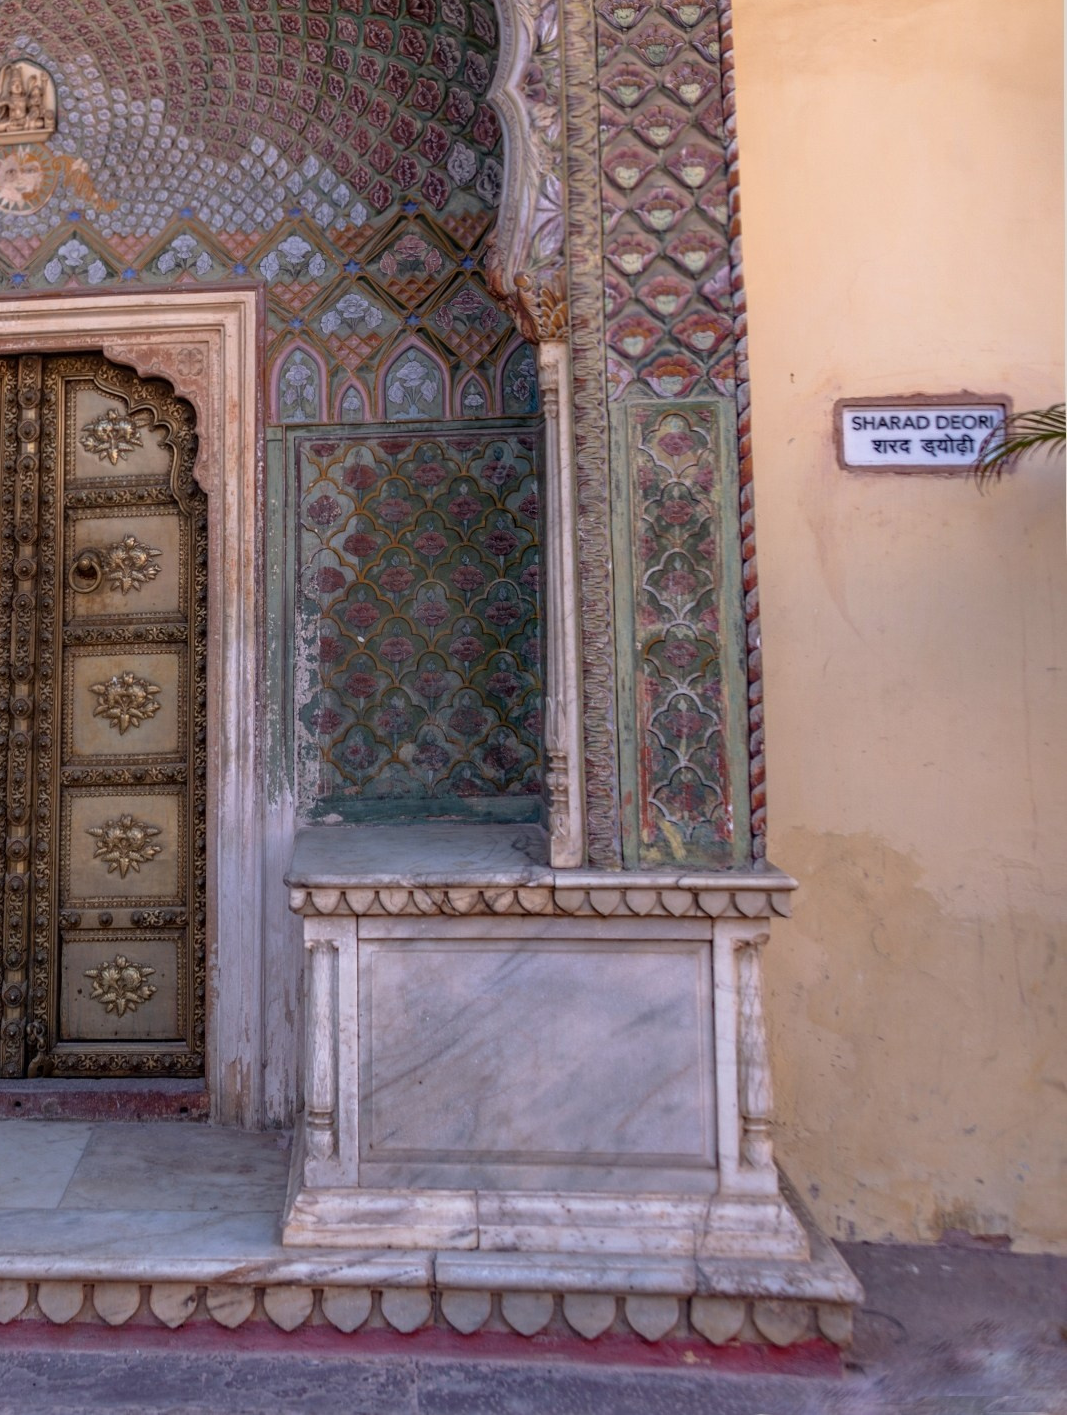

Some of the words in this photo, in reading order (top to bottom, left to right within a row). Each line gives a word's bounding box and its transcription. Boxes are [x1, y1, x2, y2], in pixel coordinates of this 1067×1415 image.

[851, 415, 930, 431] SHARAD
[935, 415, 994, 430] DEORI
[871, 439, 912, 454] शरद
